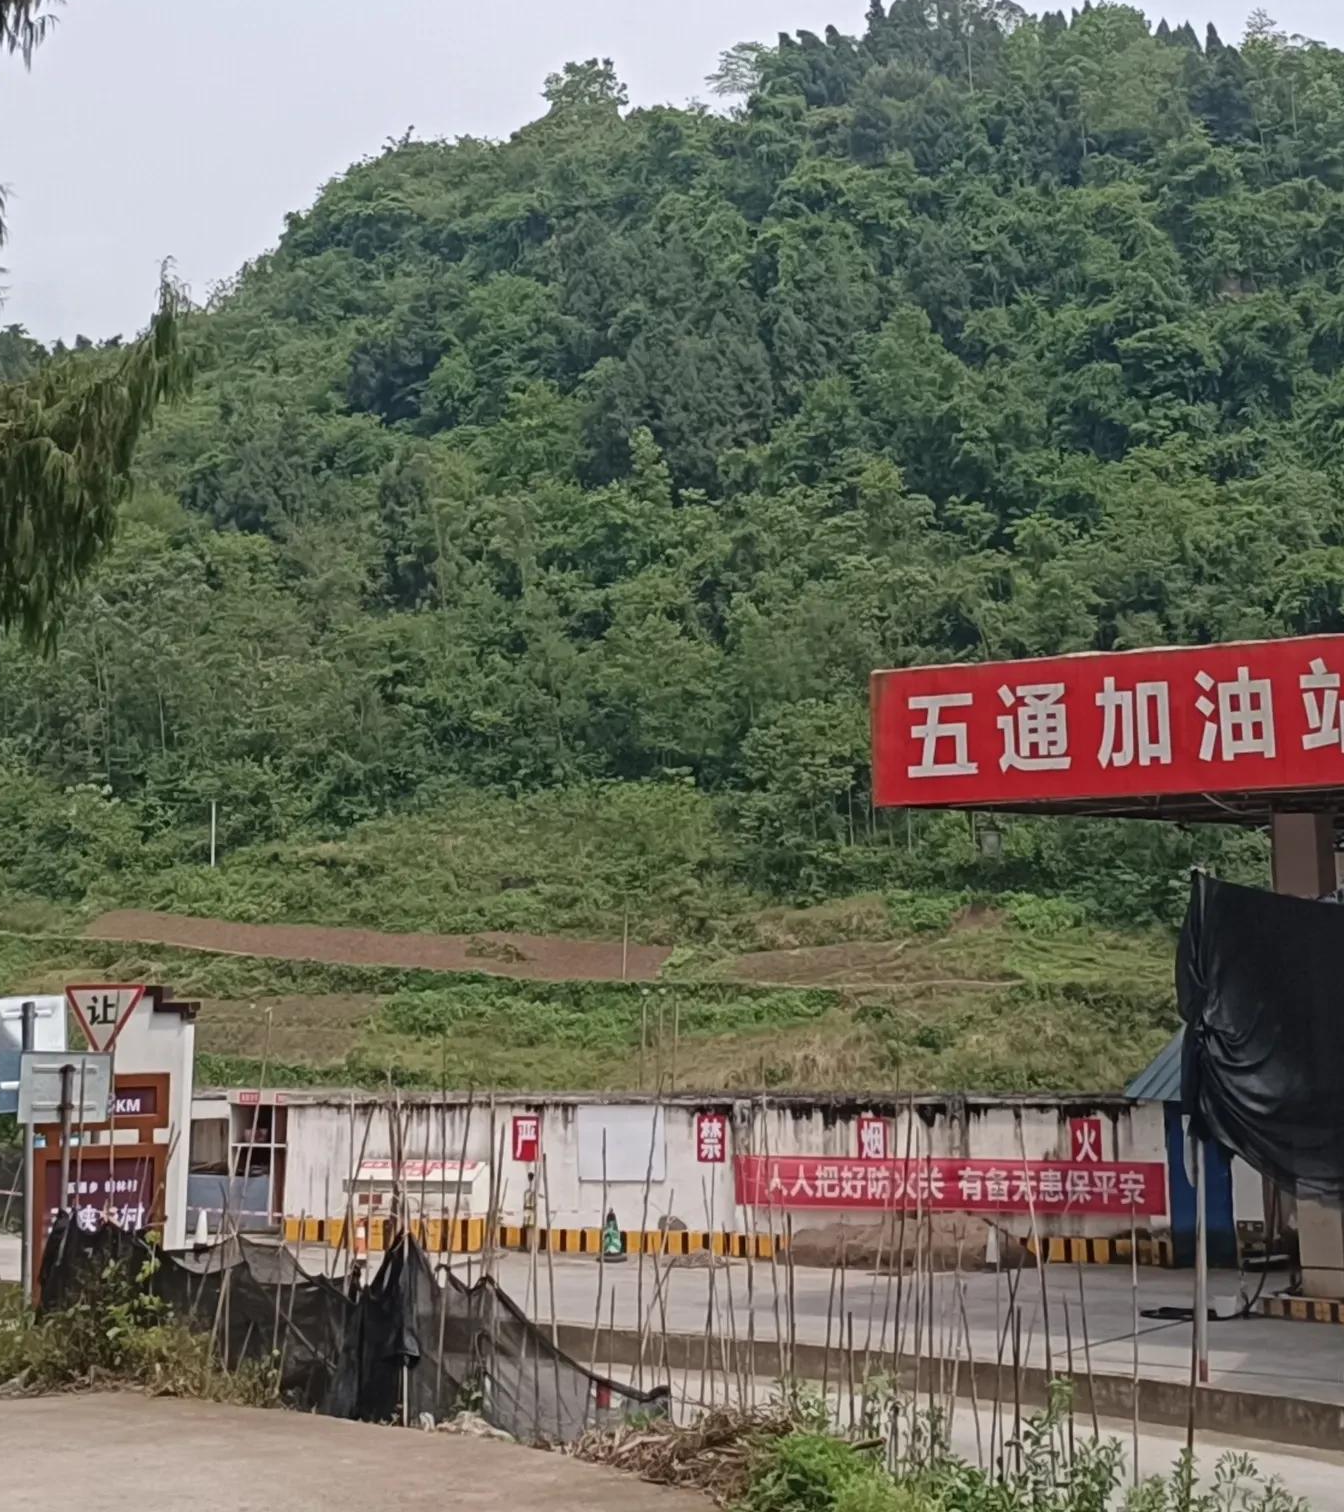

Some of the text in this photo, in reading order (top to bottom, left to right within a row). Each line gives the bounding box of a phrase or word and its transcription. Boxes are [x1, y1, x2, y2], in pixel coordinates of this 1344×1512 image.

[86, 994, 117, 1026] 让
[515, 1117, 1099, 1163] 严 禁 烟 火
[765, 1163, 1146, 1205] 人人把好防火关 有备无患保平安
